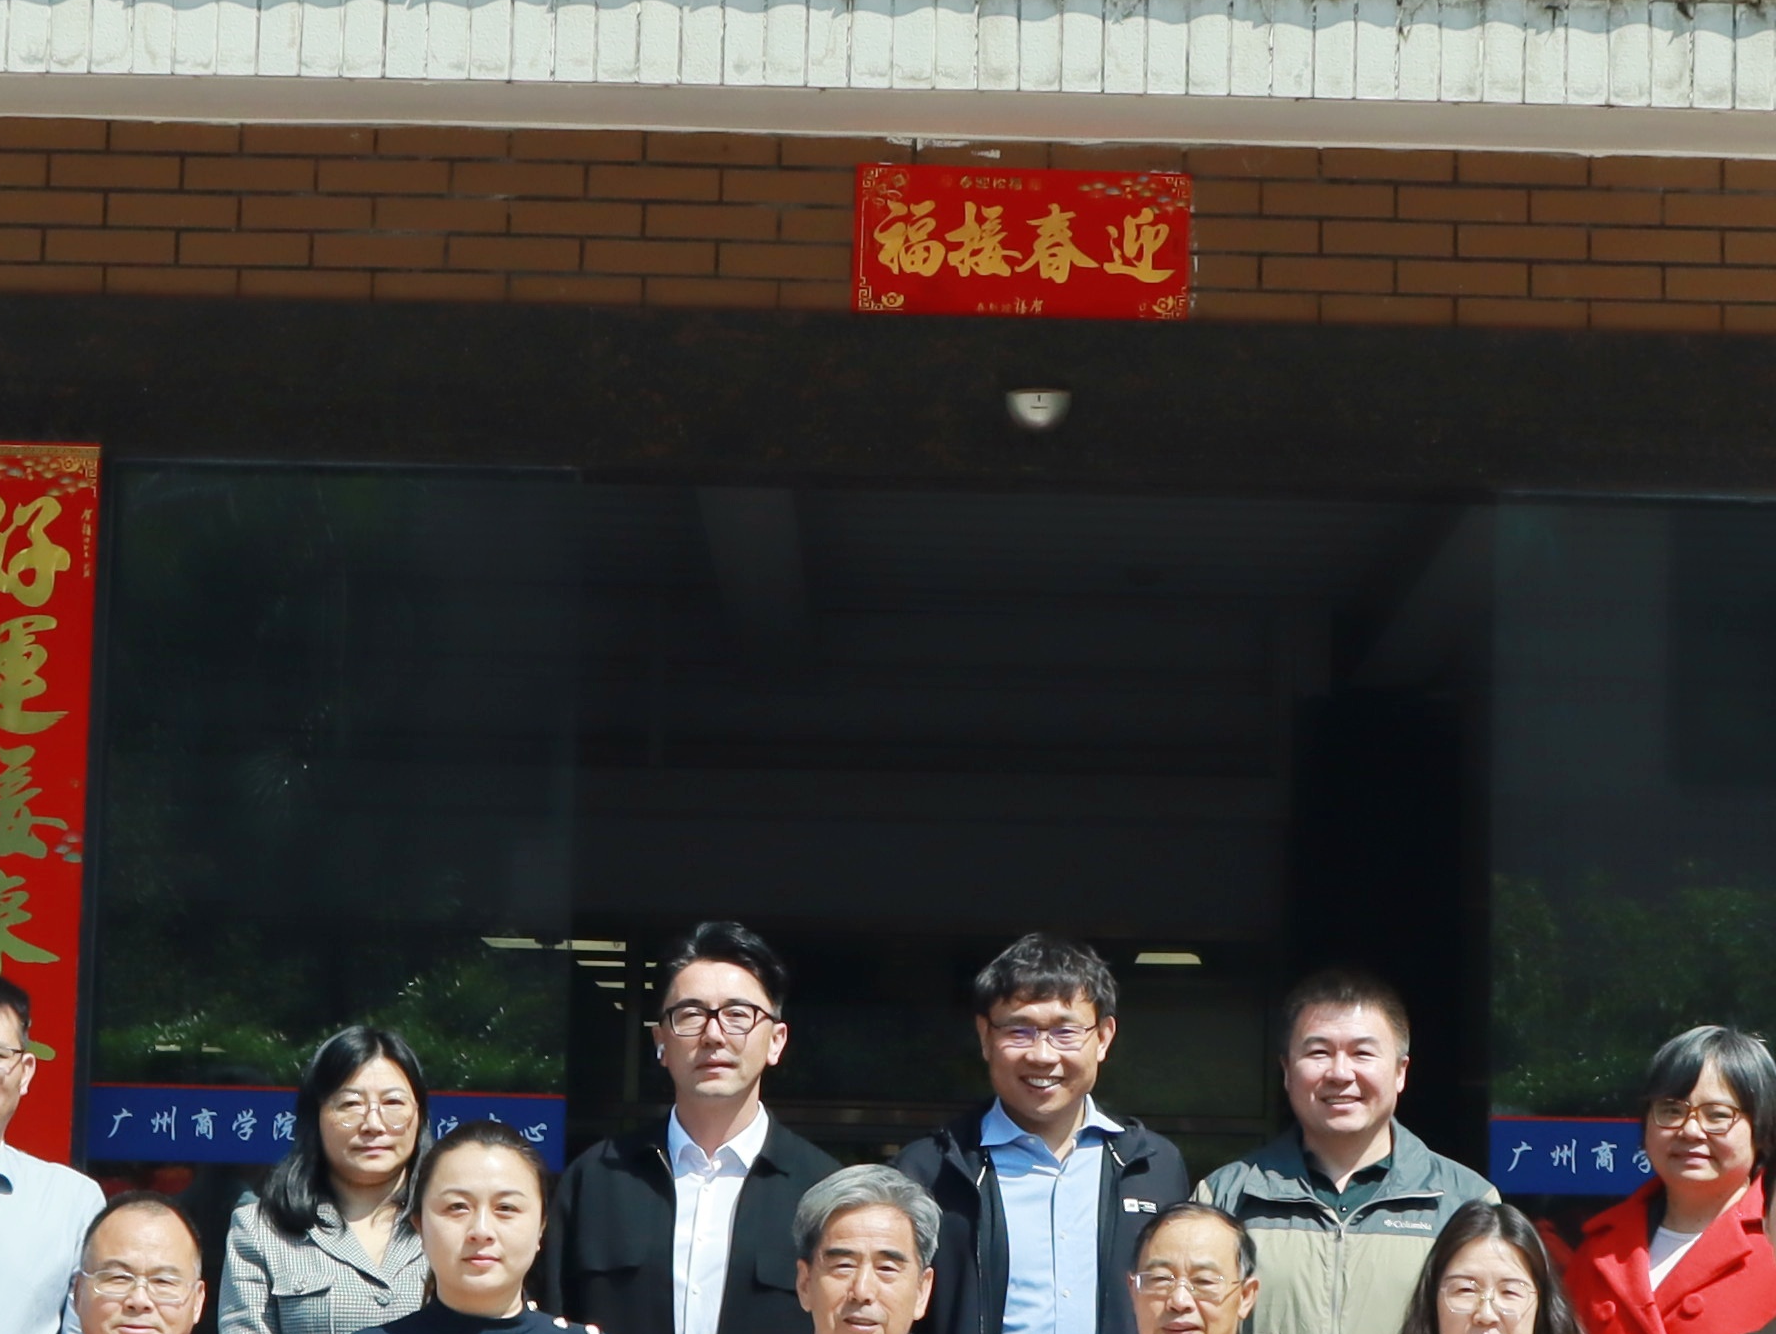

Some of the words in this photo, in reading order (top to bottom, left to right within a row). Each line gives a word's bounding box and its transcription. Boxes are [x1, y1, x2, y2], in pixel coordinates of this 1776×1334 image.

[107, 1106, 297, 1143] 广州商学院
